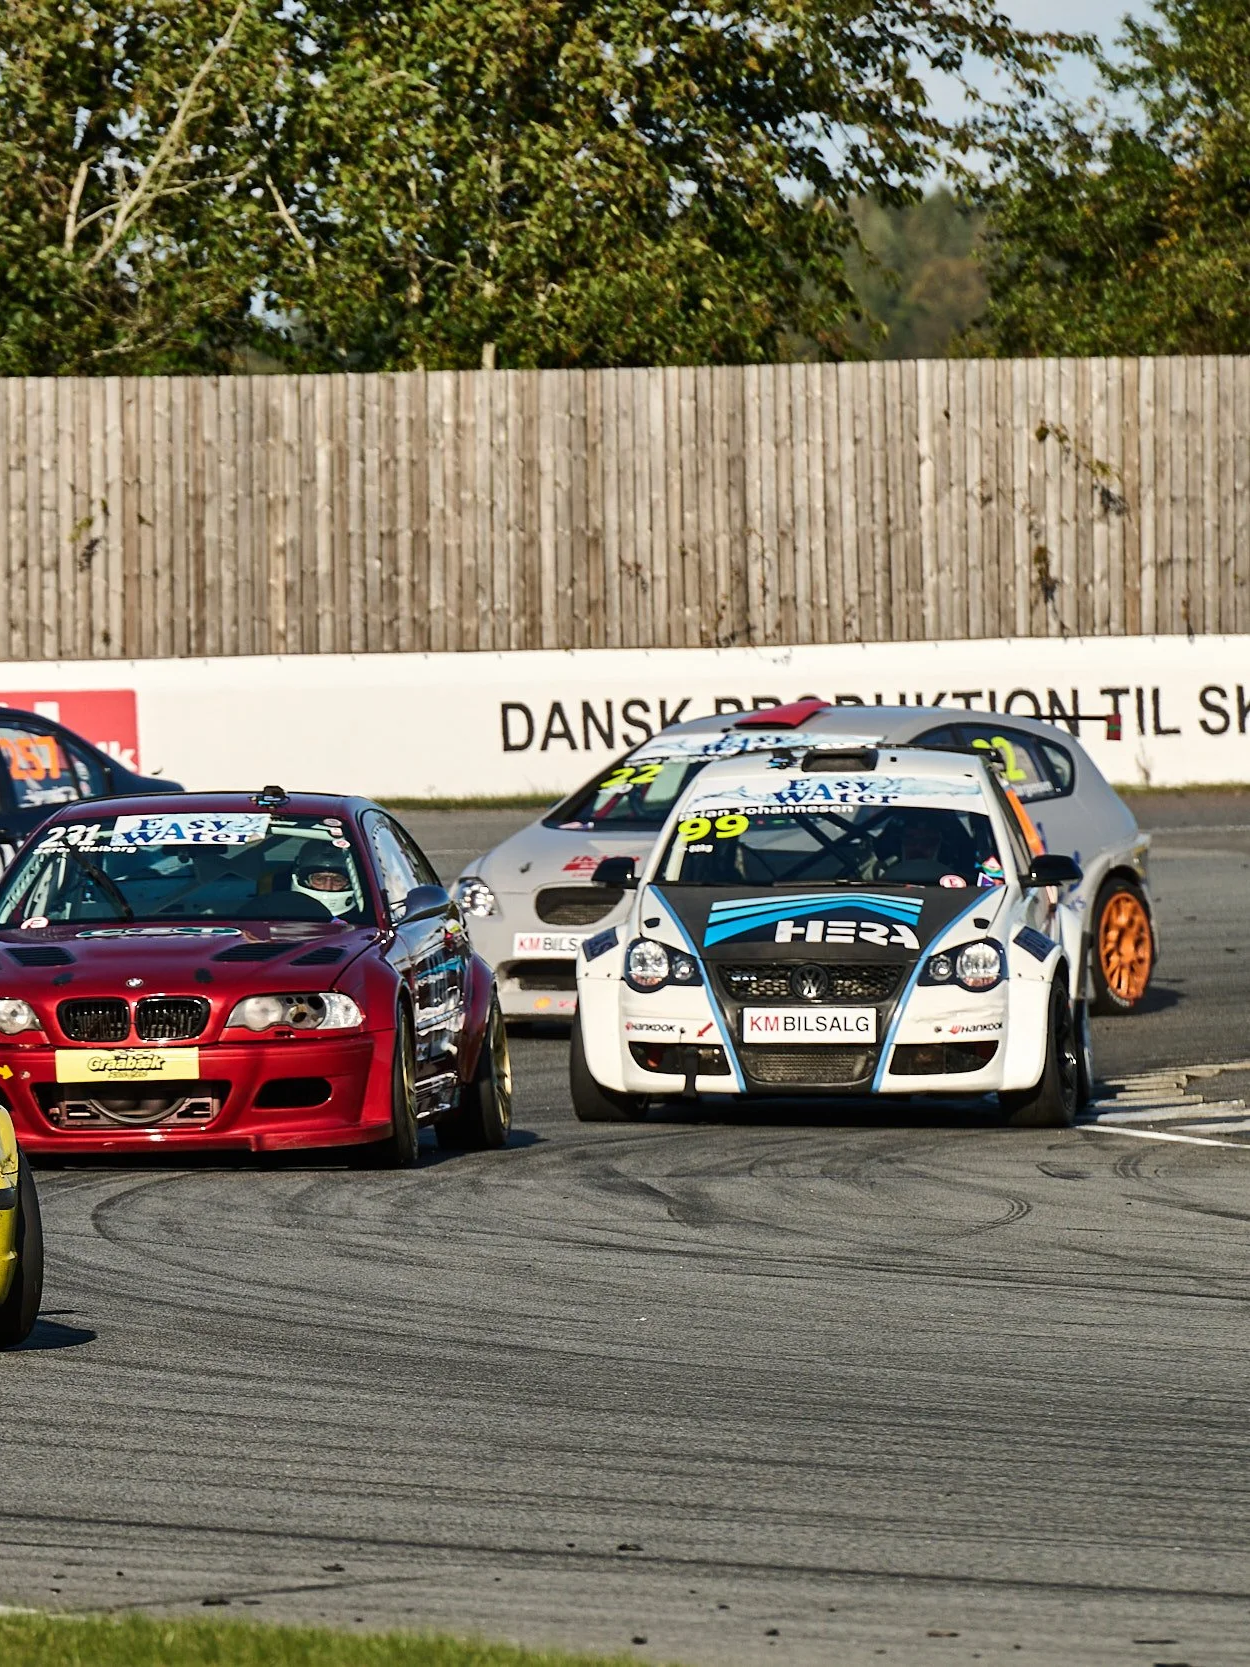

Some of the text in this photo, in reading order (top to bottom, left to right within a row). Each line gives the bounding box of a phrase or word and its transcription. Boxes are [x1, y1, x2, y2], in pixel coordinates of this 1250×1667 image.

[501, 698, 693, 751] DANSK
[1100, 687, 1181, 736] TIL
[600, 764, 664, 789] 22
[736, 804, 854, 815] Johannesen
[38, 824, 101, 848] 231
[678, 815, 749, 842] 99
[774, 920, 921, 950] HERA
[88, 1056, 166, 1072] Graabæk
